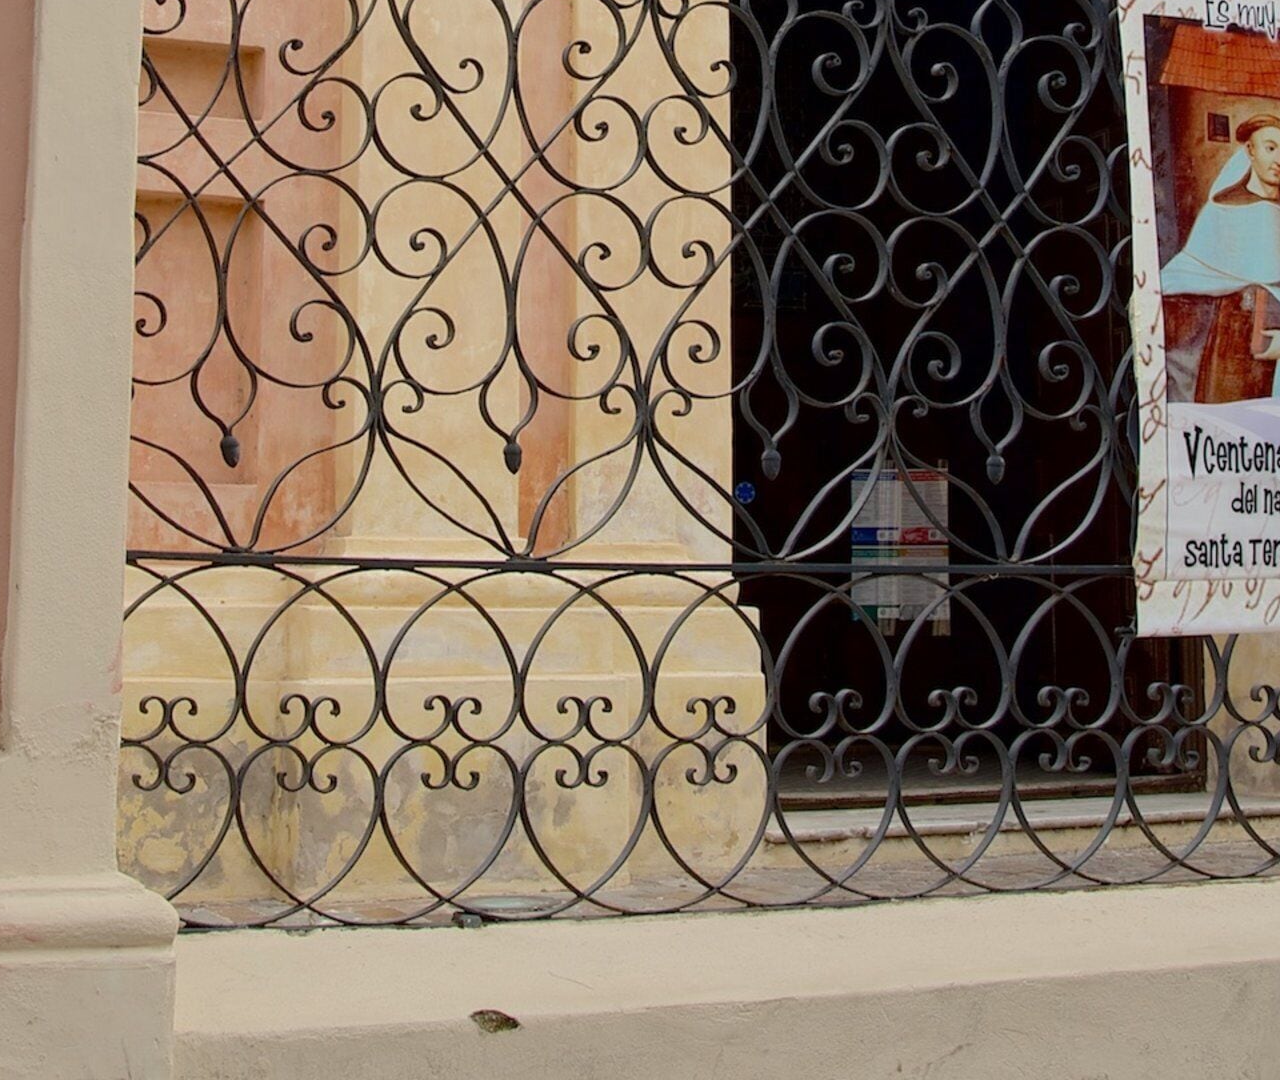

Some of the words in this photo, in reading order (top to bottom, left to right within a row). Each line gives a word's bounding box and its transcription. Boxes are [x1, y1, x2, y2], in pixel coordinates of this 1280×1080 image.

[1237, 2, 1276, 38] muy
[1184, 426, 1203, 480] V
[1231, 482, 1257, 513] del
